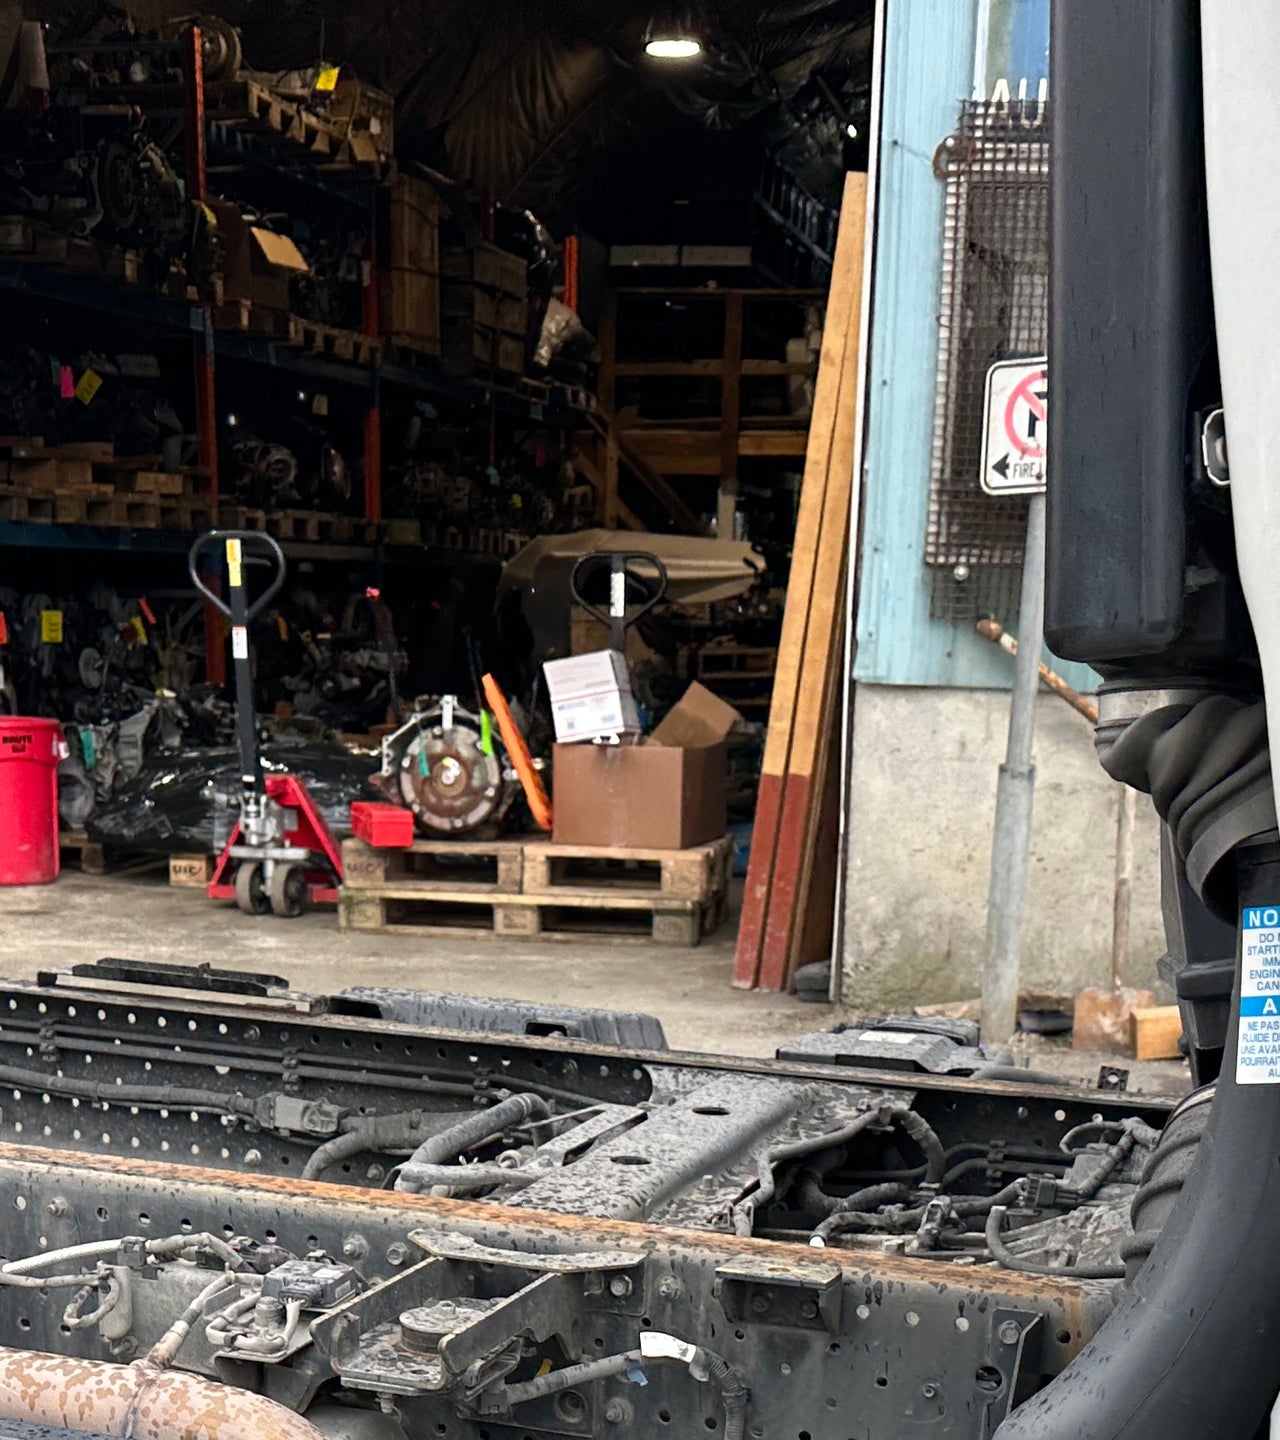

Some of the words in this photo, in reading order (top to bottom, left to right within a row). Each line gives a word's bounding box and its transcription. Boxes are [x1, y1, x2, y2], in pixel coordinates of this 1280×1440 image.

[1259, 933, 1275, 943] DO
[1257, 981, 1280, 991] CAN
[1248, 1021, 1258, 1031] NE
[1260, 1020, 1280, 1031] PAS
[1241, 1045, 1256, 1055] UNE
